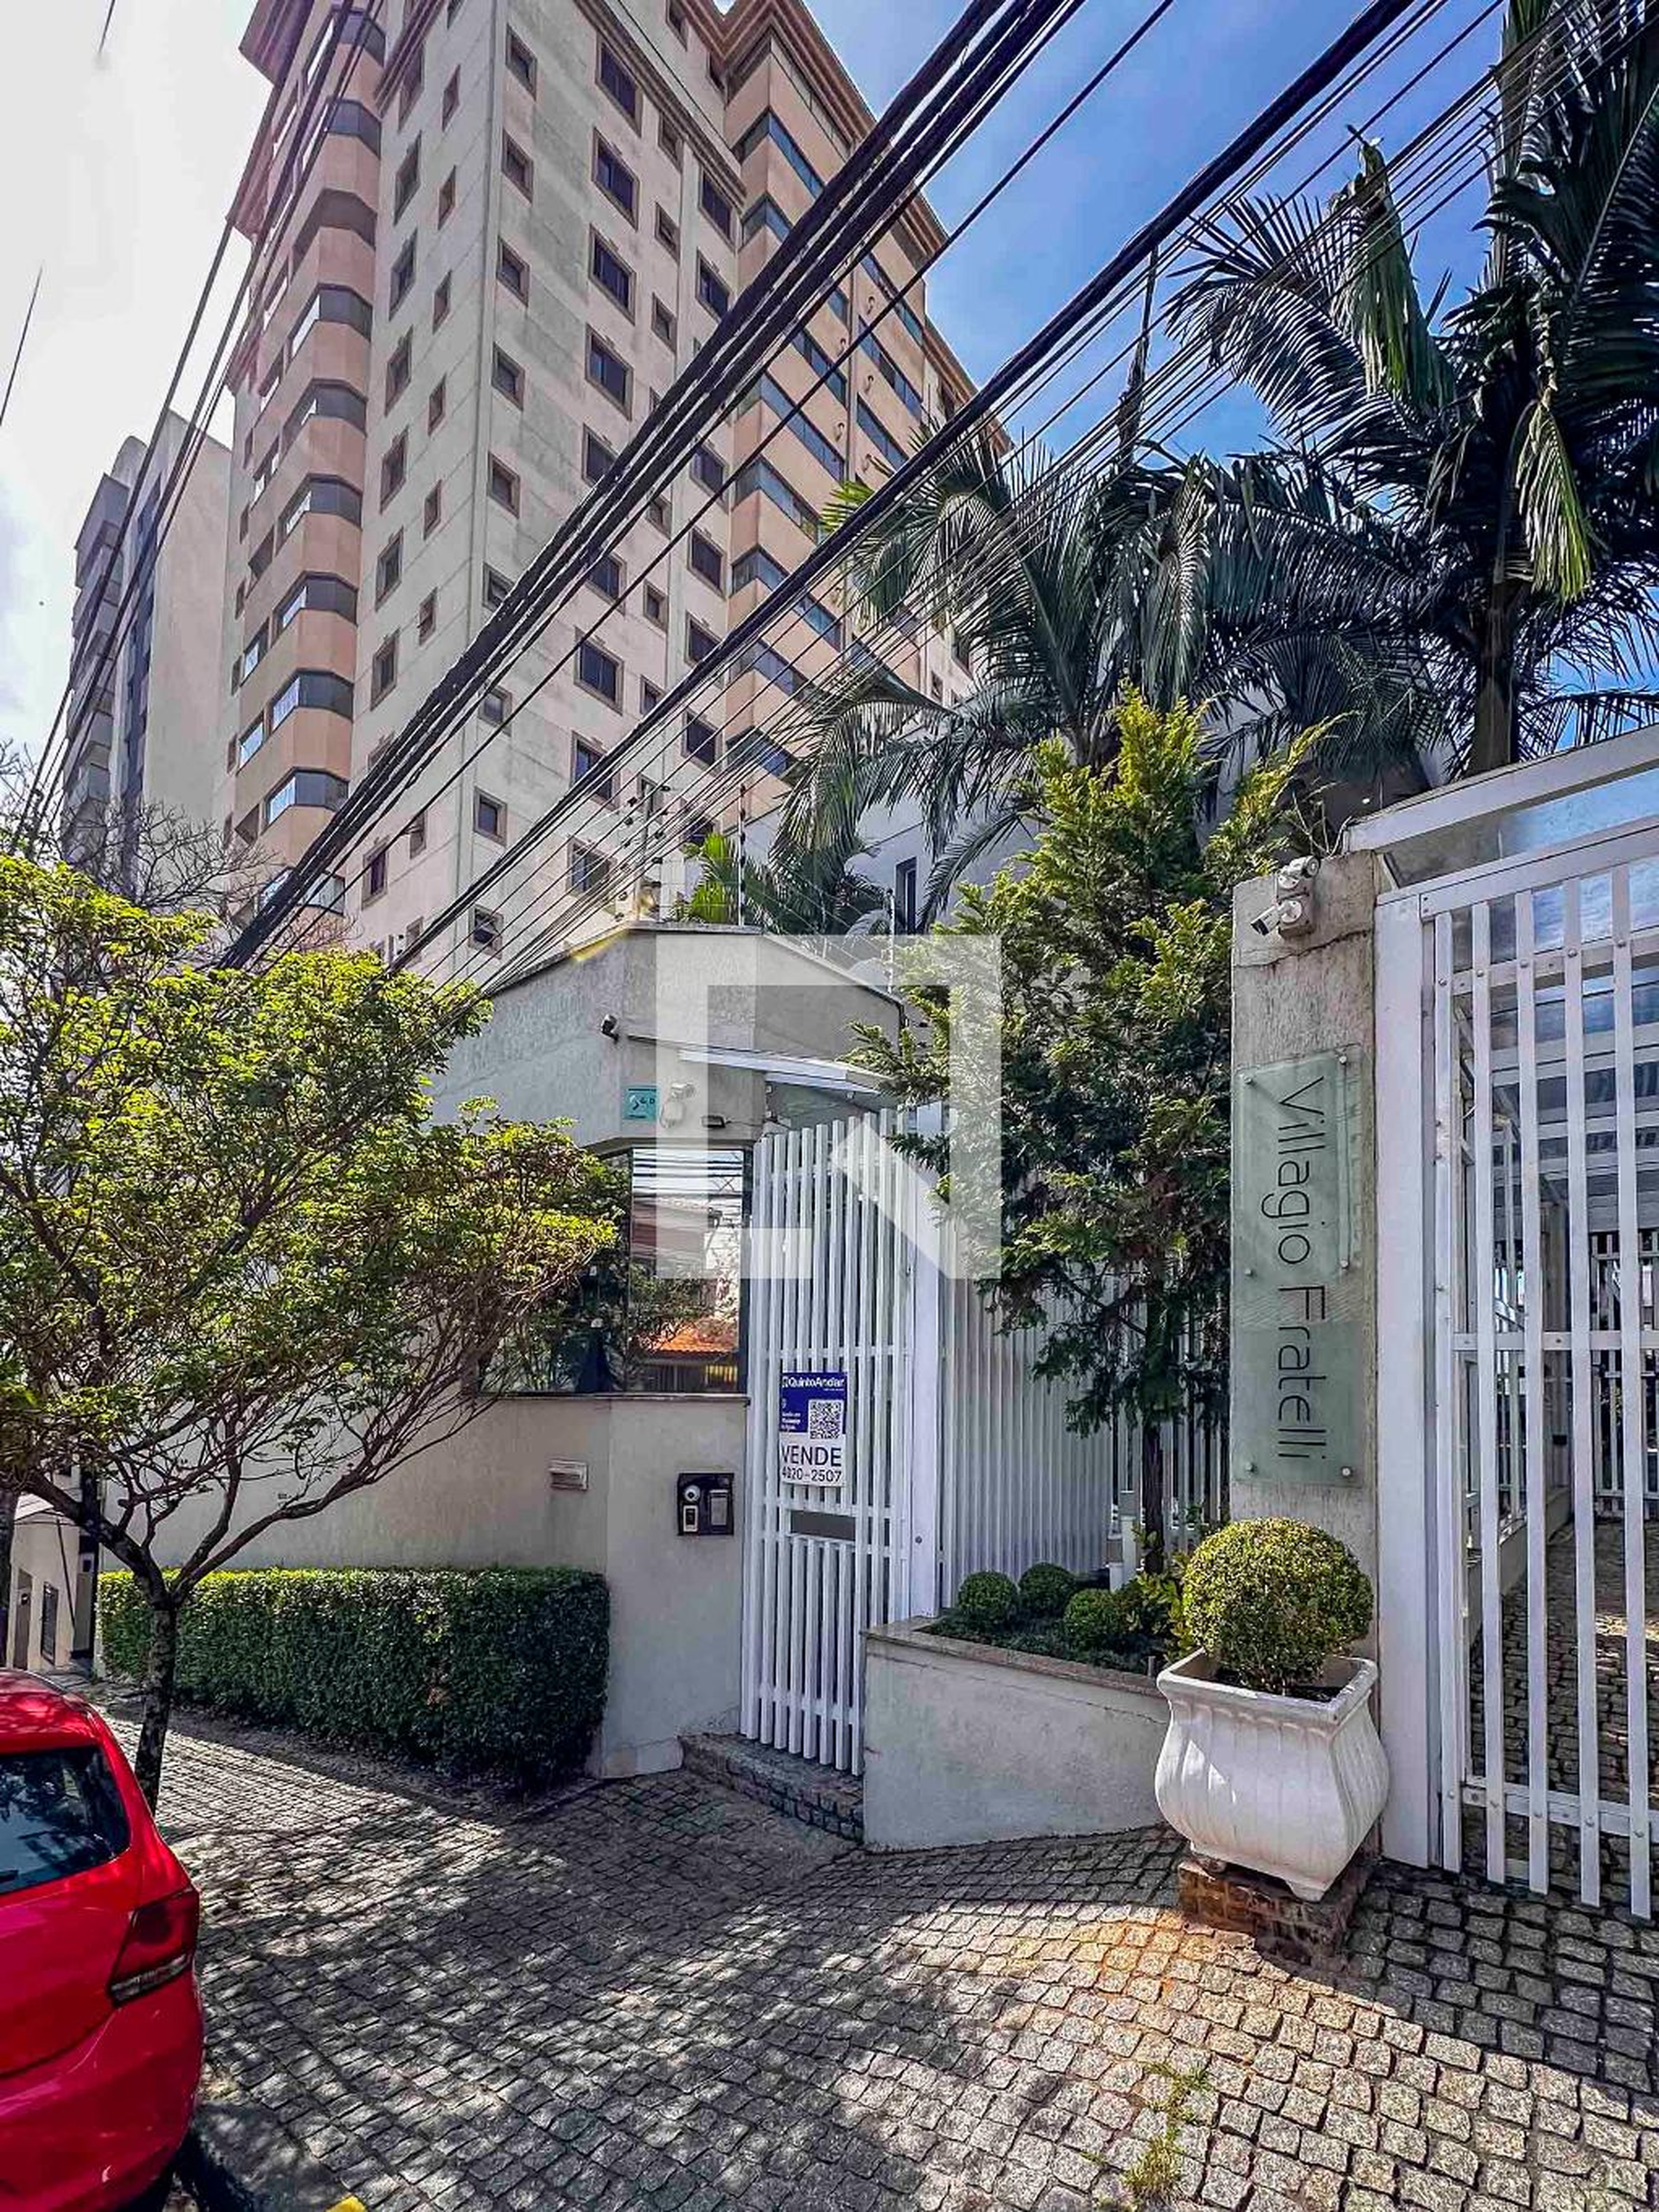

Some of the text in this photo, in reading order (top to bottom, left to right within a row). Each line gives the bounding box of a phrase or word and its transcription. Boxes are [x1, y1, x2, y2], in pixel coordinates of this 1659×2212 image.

[1262, 1076, 1326, 1459] Villagio Fratelli
[788, 1377, 845, 1388] QuintoAndar
[781, 1445, 842, 1467] VENDE
